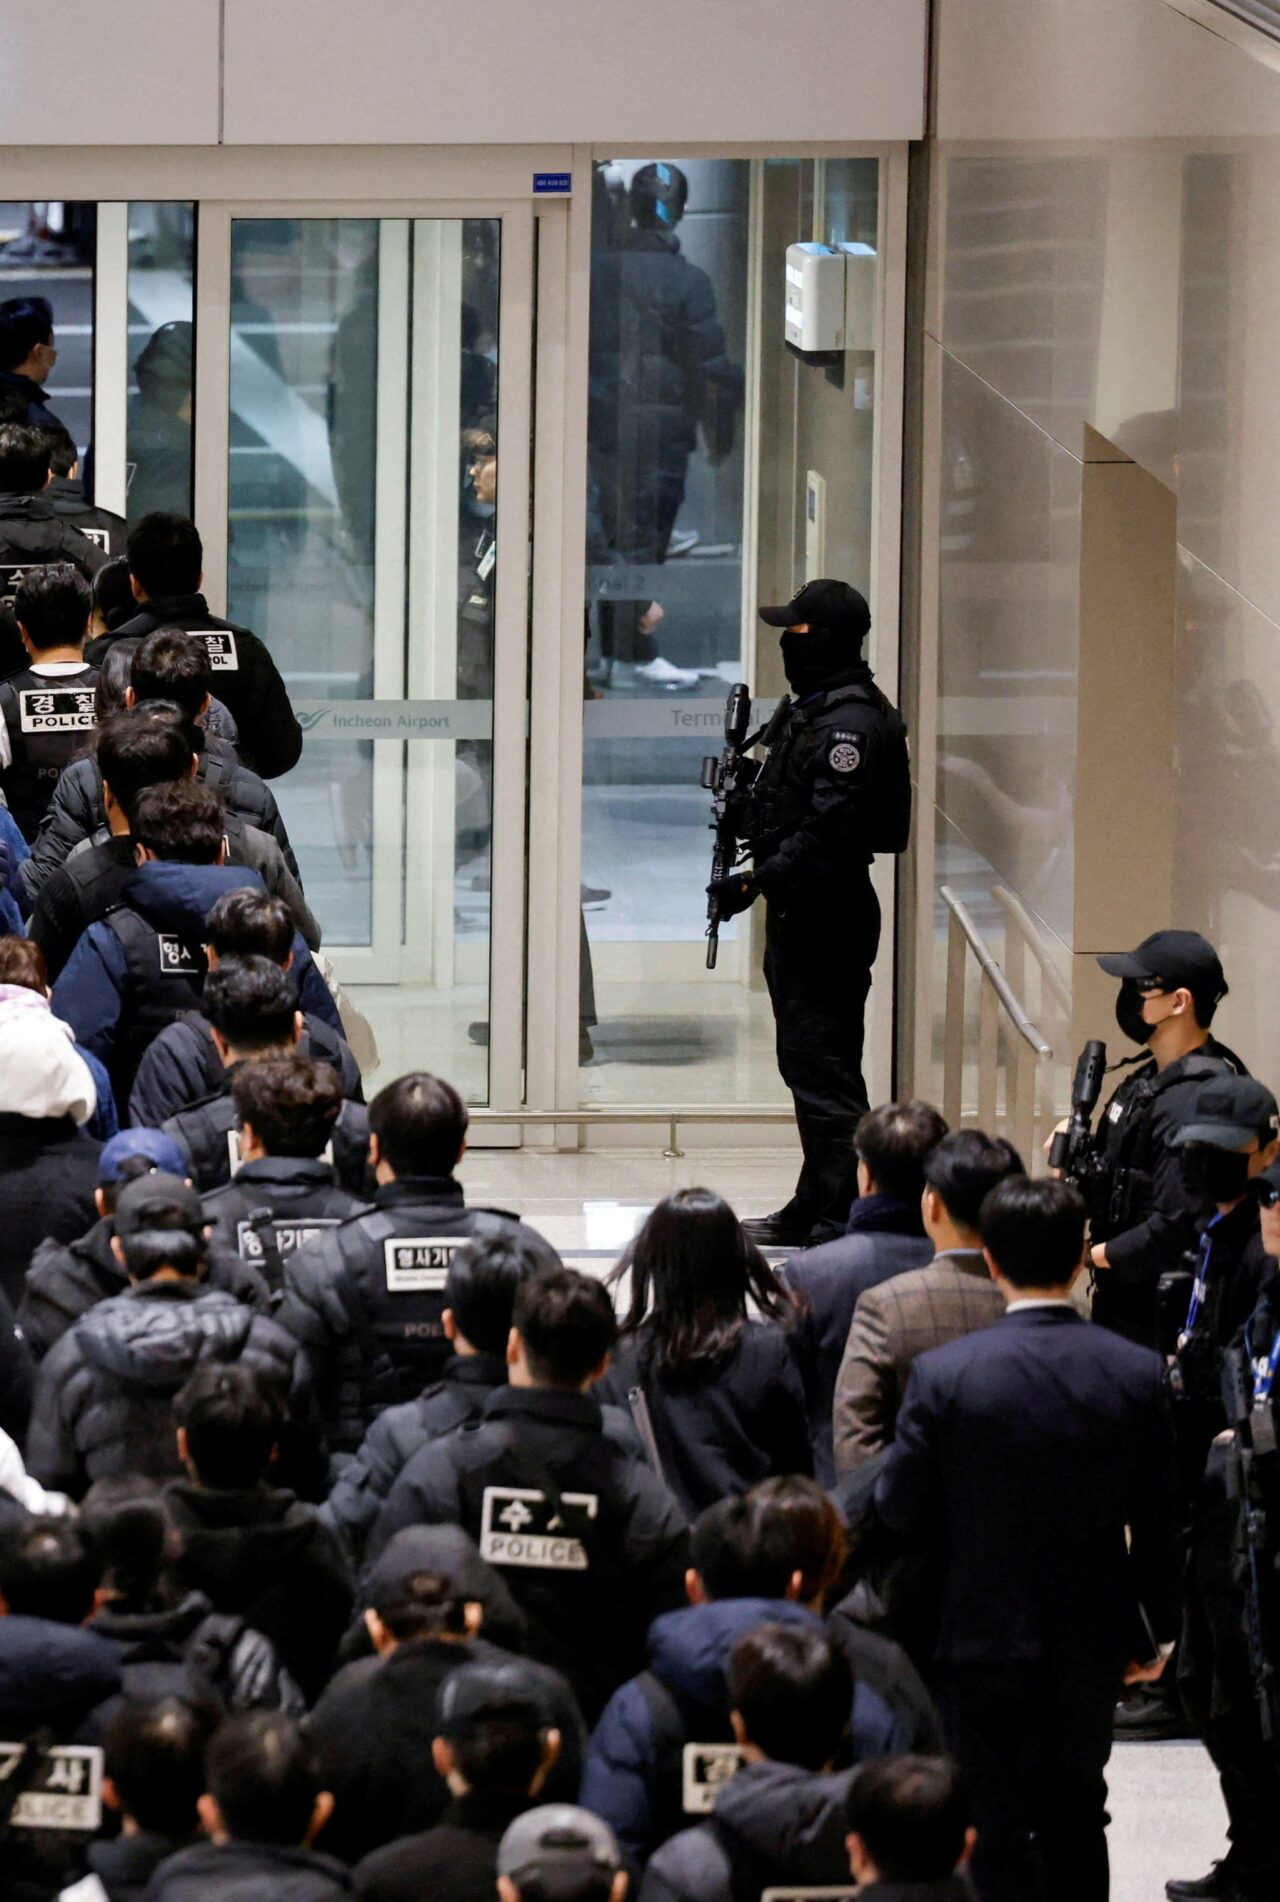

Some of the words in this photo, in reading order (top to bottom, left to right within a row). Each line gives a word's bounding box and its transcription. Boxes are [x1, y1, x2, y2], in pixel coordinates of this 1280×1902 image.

[205, 636, 224, 652] 찰
[212, 656, 228, 664] OL
[333, 714, 392, 728] Incheon
[396, 714, 450, 730] Airport
[404, 1323, 438, 1337] POL
[490, 1538, 581, 1562] POLICE
